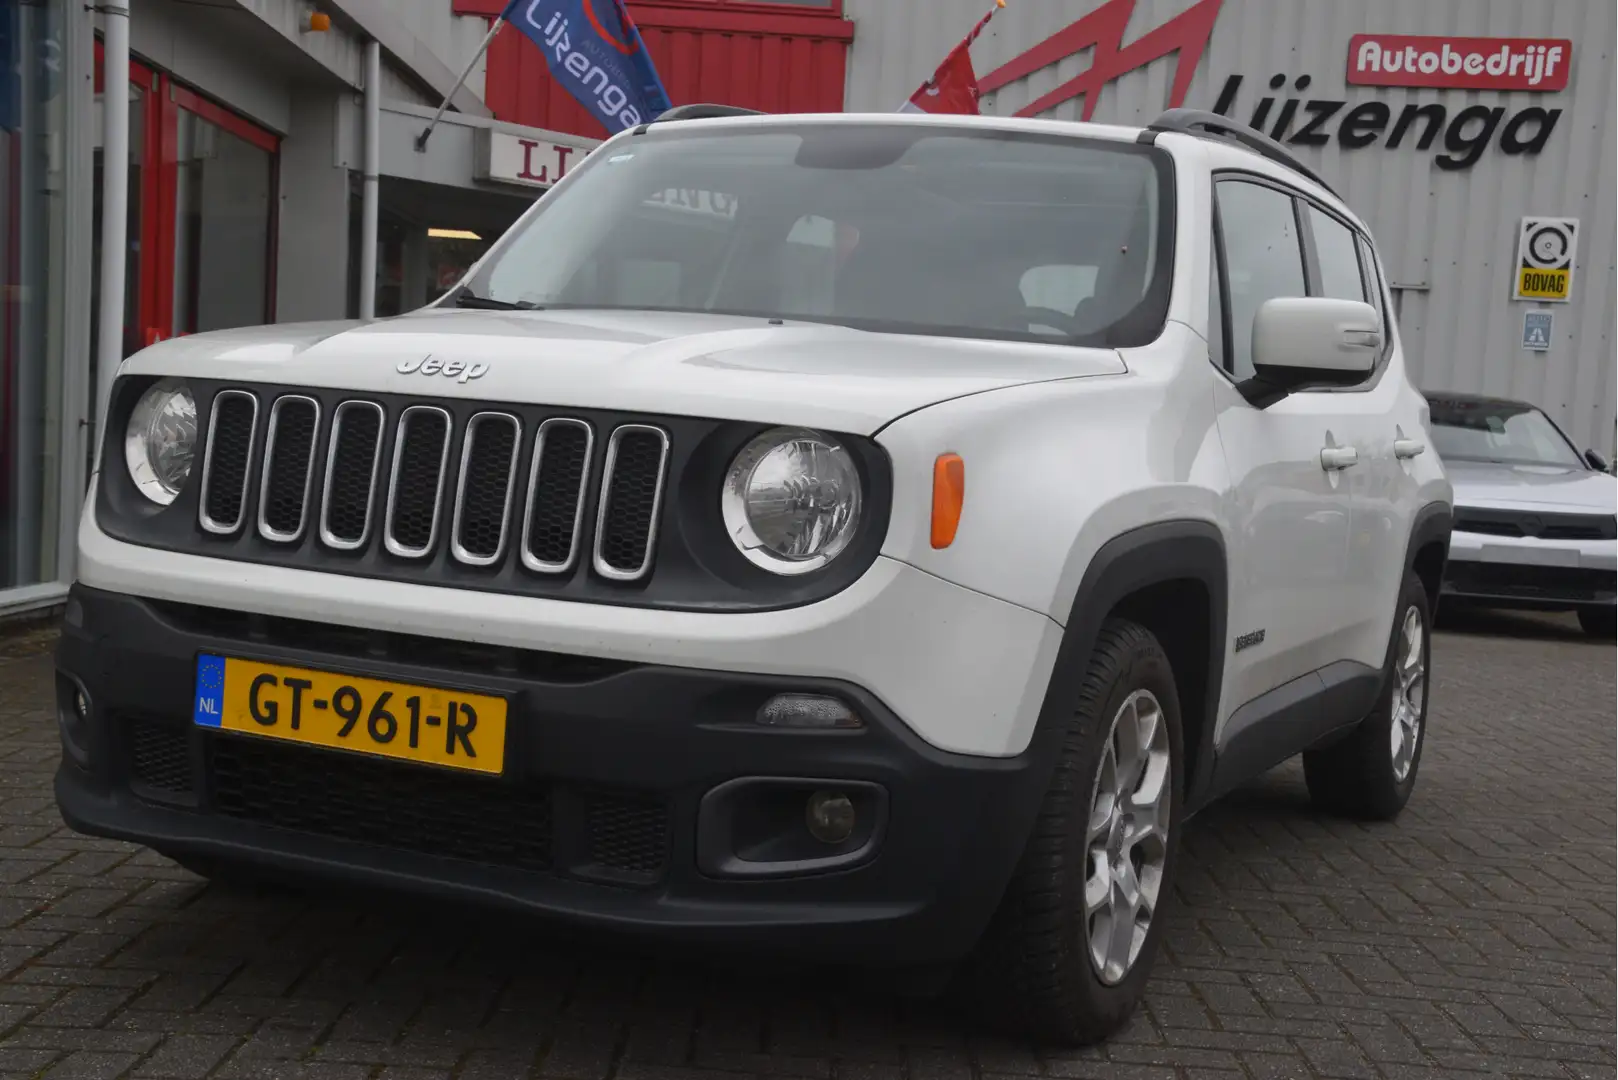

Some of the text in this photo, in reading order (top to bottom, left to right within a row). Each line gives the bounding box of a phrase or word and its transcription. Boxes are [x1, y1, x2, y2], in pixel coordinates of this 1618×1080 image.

[1356, 41, 1562, 85] Autobedrijf
[517, 139, 591, 184] LI
[1523, 273, 1565, 293] BOVAG
[396, 353, 490, 384] Jeep
[199, 696, 218, 715] NL
[248, 673, 477, 758] GT-961-R
